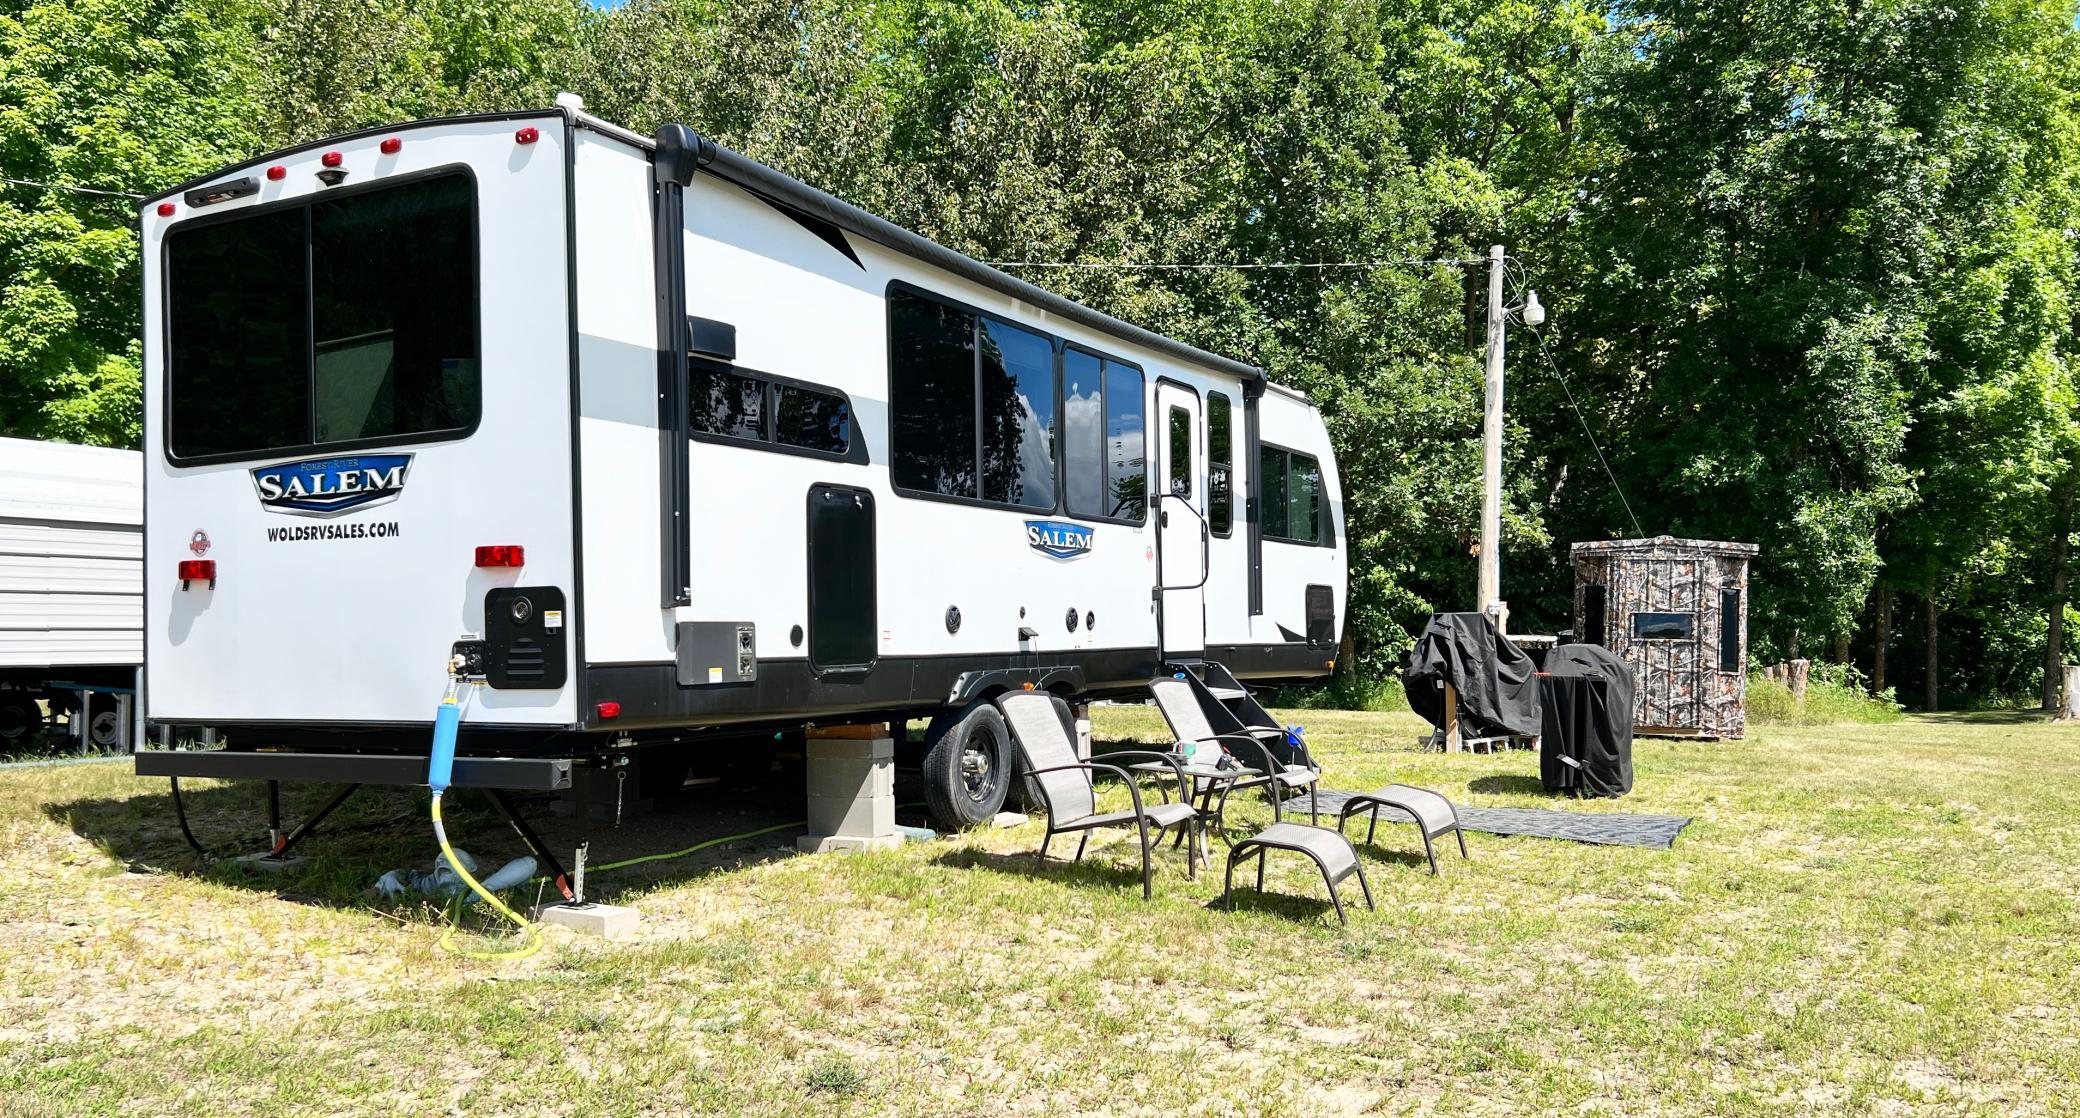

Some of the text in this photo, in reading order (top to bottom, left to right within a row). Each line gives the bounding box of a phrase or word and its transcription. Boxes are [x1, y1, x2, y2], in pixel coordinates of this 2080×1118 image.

[259, 466, 405, 500] SALEM
[267, 522, 400, 542] WOLDSRVSALES.COM
[1028, 526, 1092, 549] SALEM
